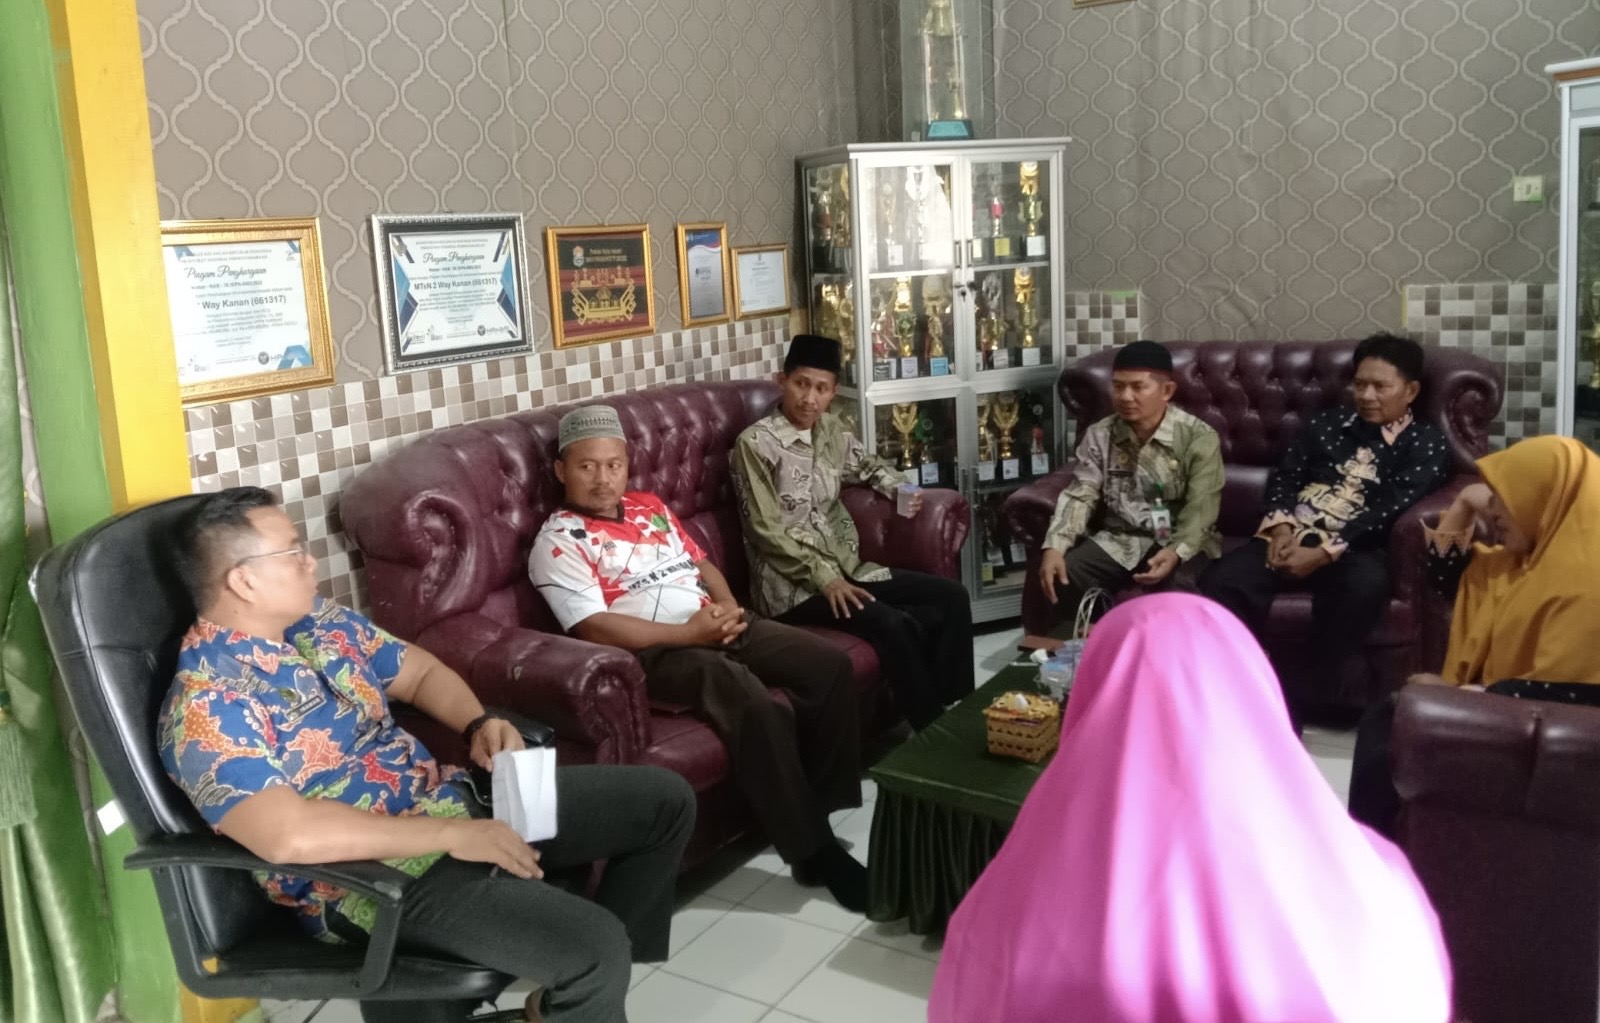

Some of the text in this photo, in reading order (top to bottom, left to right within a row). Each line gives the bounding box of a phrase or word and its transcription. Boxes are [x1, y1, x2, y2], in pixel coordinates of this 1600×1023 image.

[438, 281, 451, 290] Way
[452, 279, 472, 287] Kanan
[202, 294, 287, 310] Way Kanan (661317)
